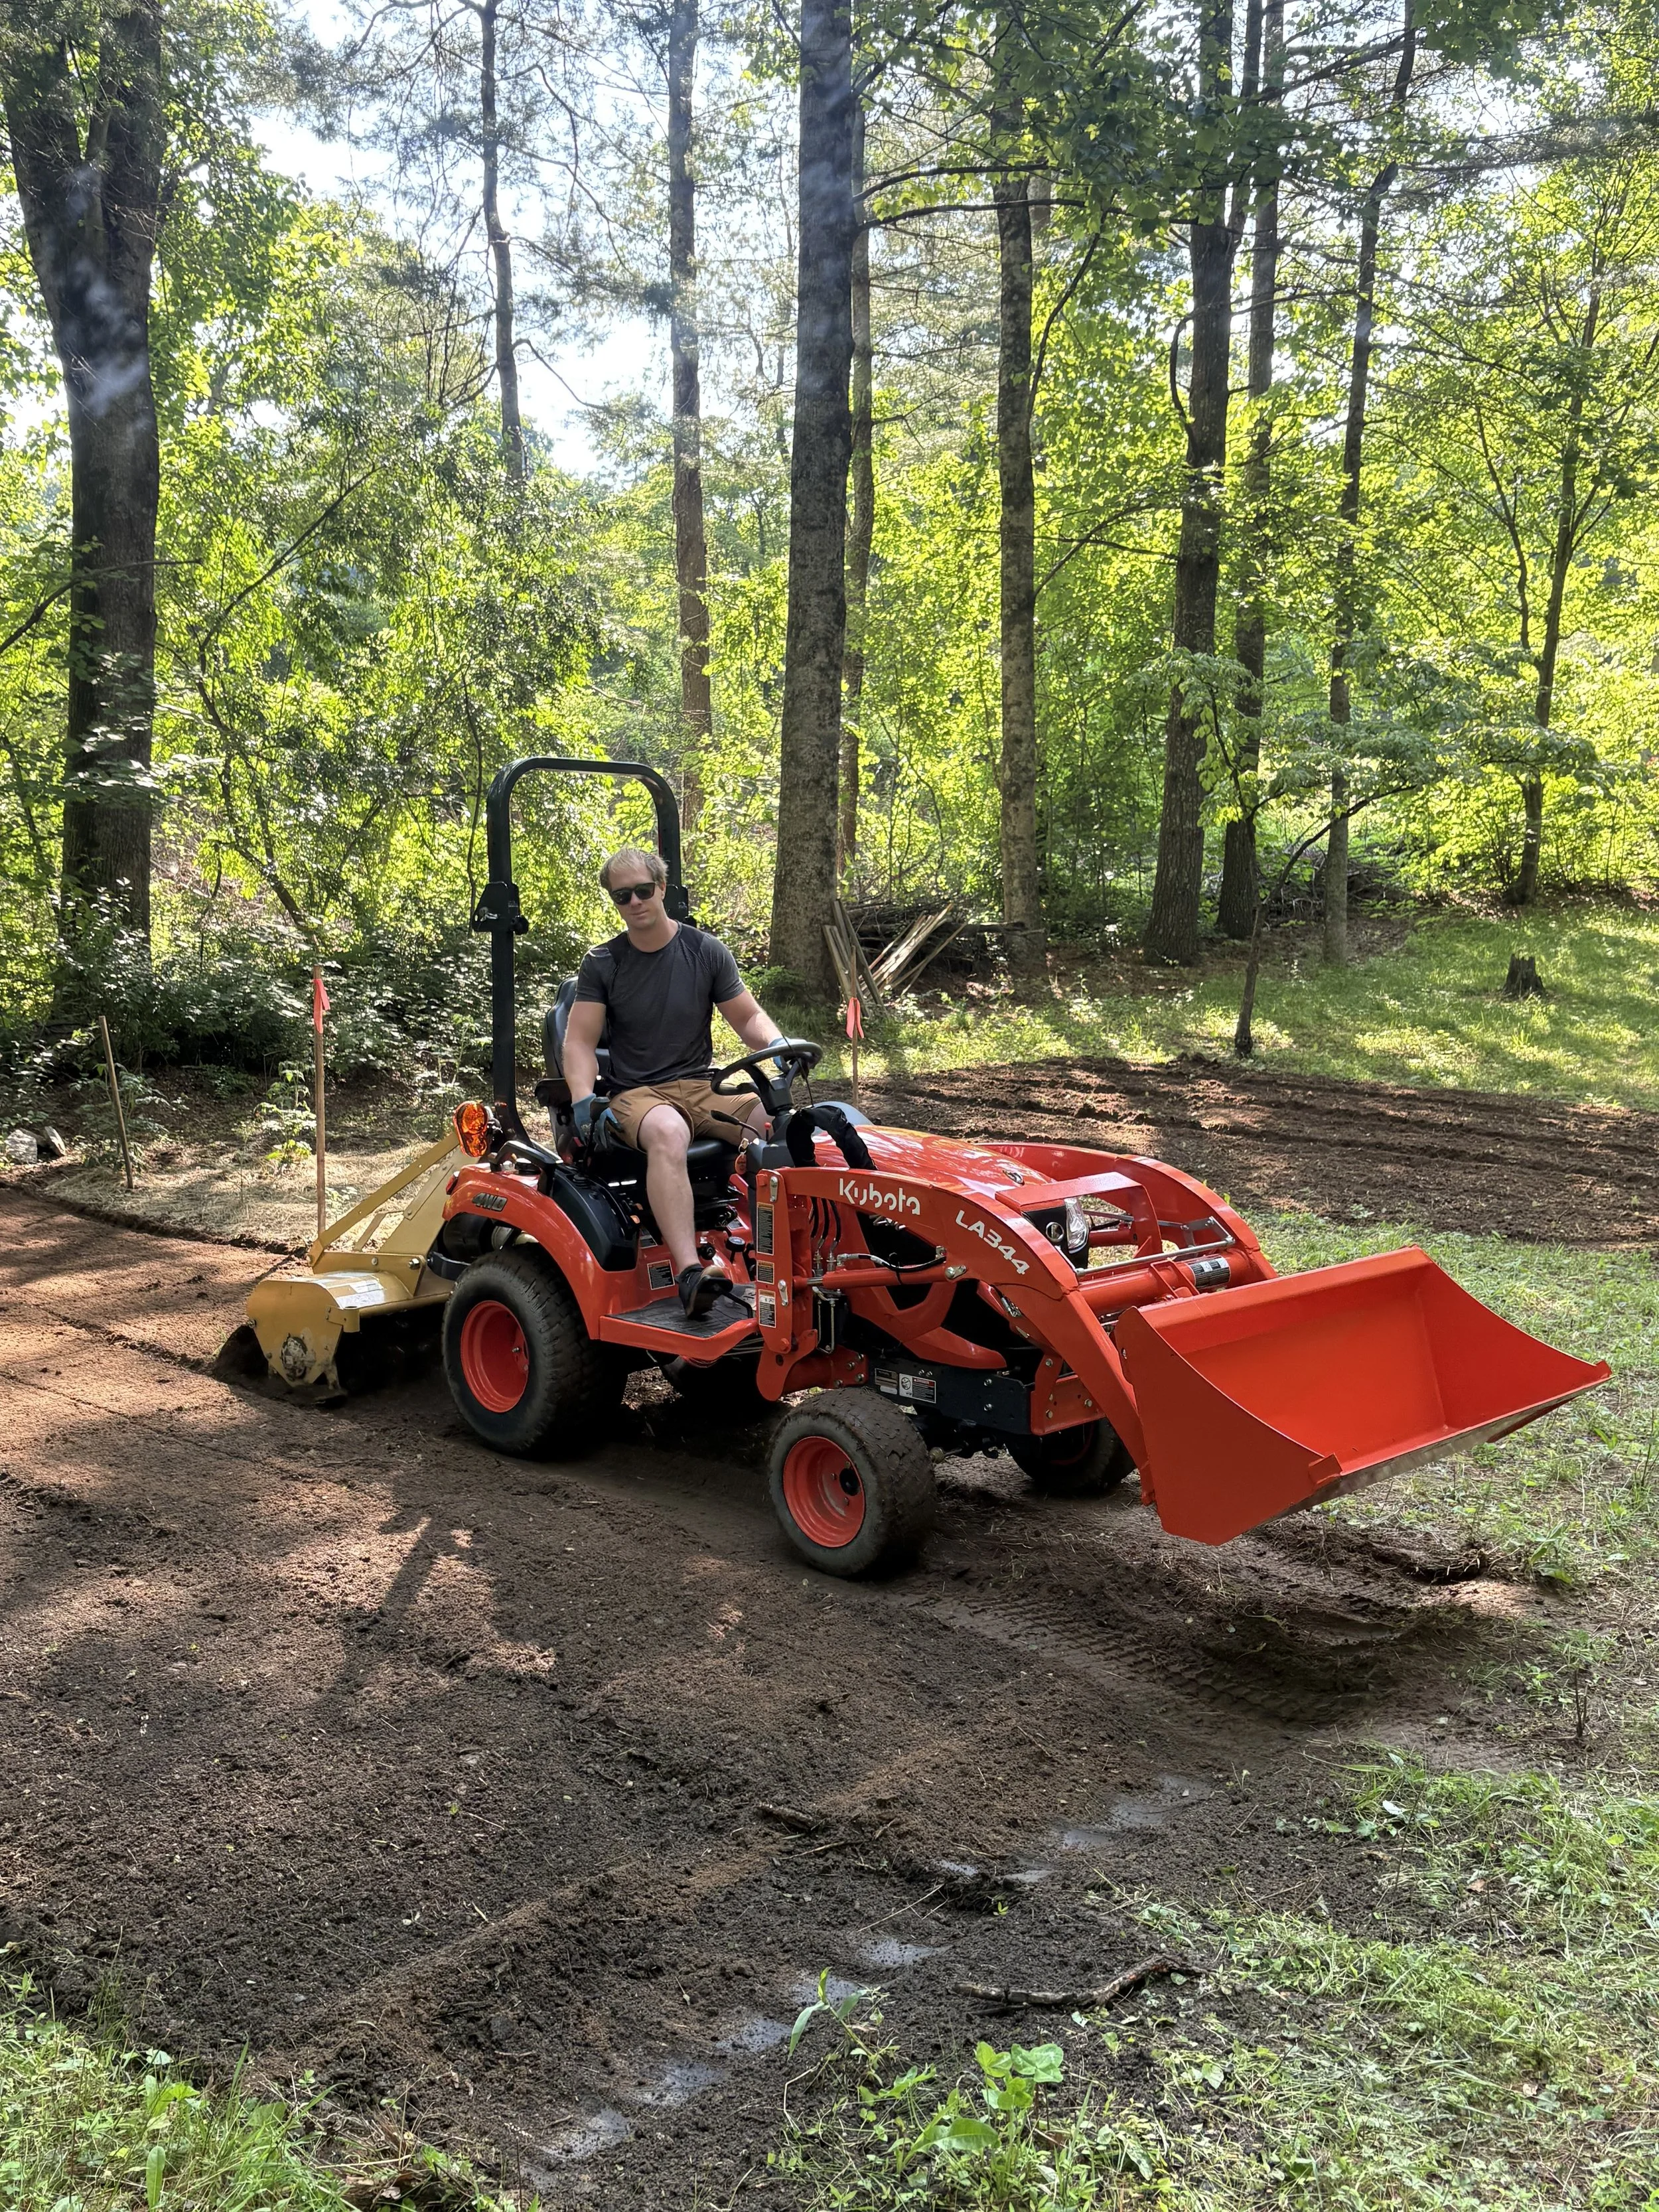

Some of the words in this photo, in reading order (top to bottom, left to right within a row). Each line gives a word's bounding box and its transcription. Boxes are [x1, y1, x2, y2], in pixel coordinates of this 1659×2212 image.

[472, 1193, 508, 1211] 4WD
[839, 1178, 920, 1216] Kubota
[956, 1210, 1030, 1275] LA344
